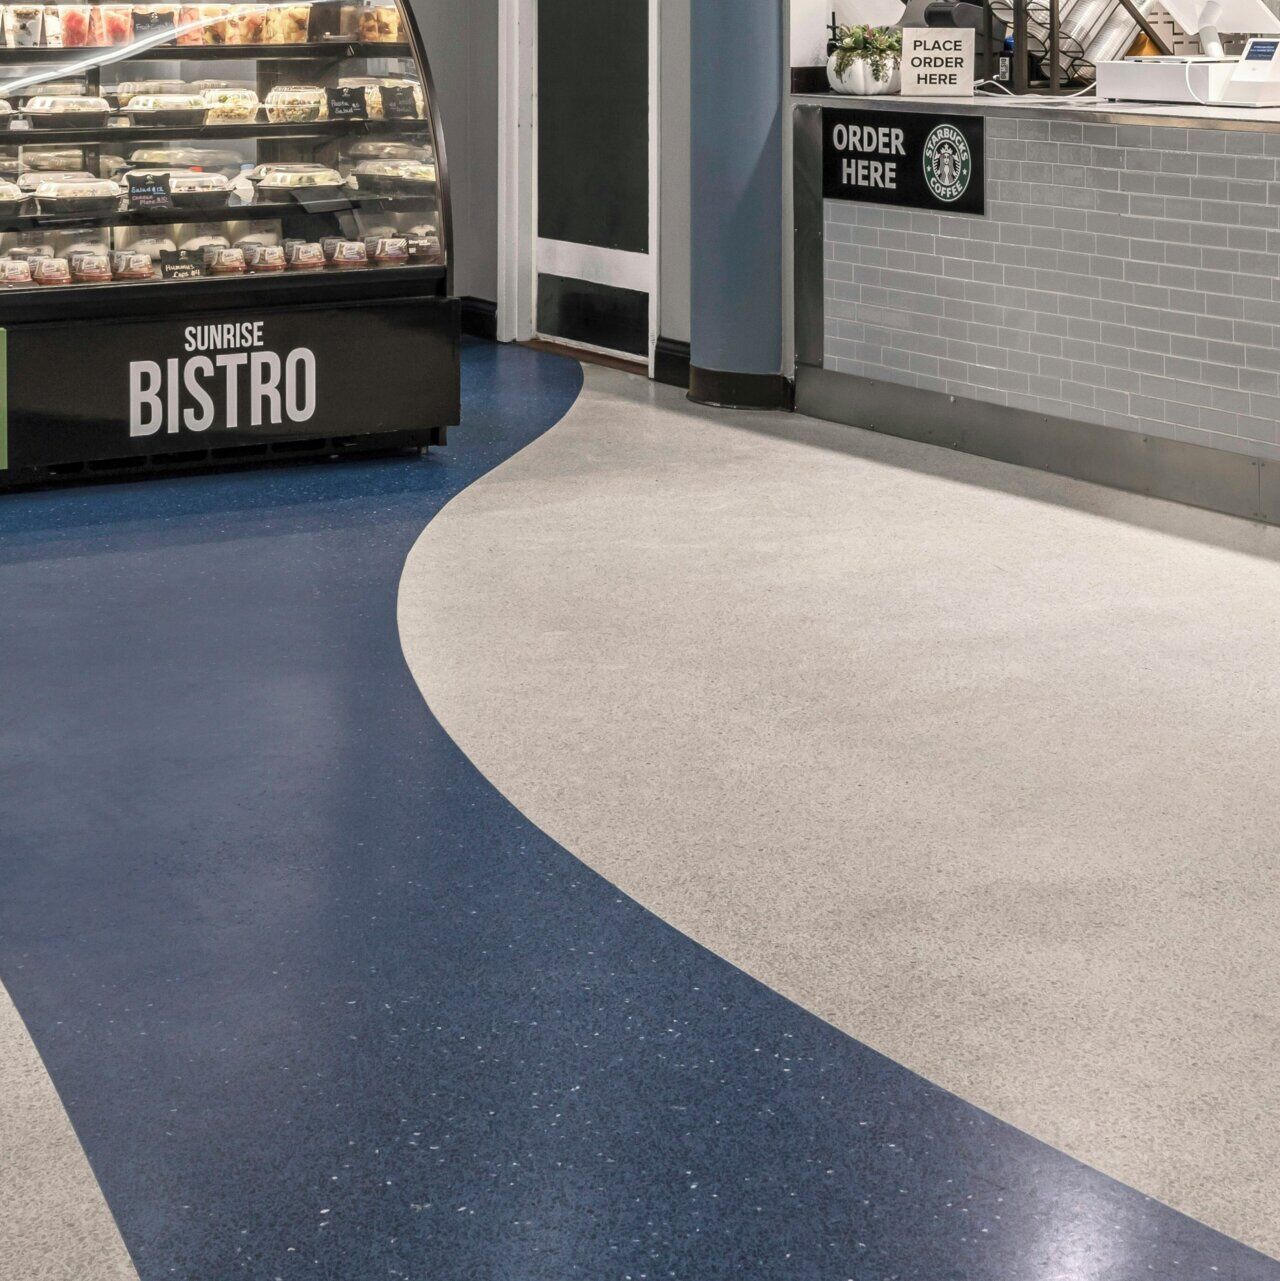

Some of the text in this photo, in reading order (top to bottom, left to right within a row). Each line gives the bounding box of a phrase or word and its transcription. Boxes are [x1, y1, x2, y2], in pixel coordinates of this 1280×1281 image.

[913, 39, 962, 52] PLACE
[910, 56, 964, 69] ORDER
[916, 73, 958, 86] HERE
[832, 123, 907, 156] ORDER
[924, 127, 970, 162] STARBUCKS
[841, 158, 897, 190] HERE
[929, 178, 964, 199] COFFEE
[183, 321, 265, 352] SUNRISE
[128, 347, 317, 438] BISTRO
